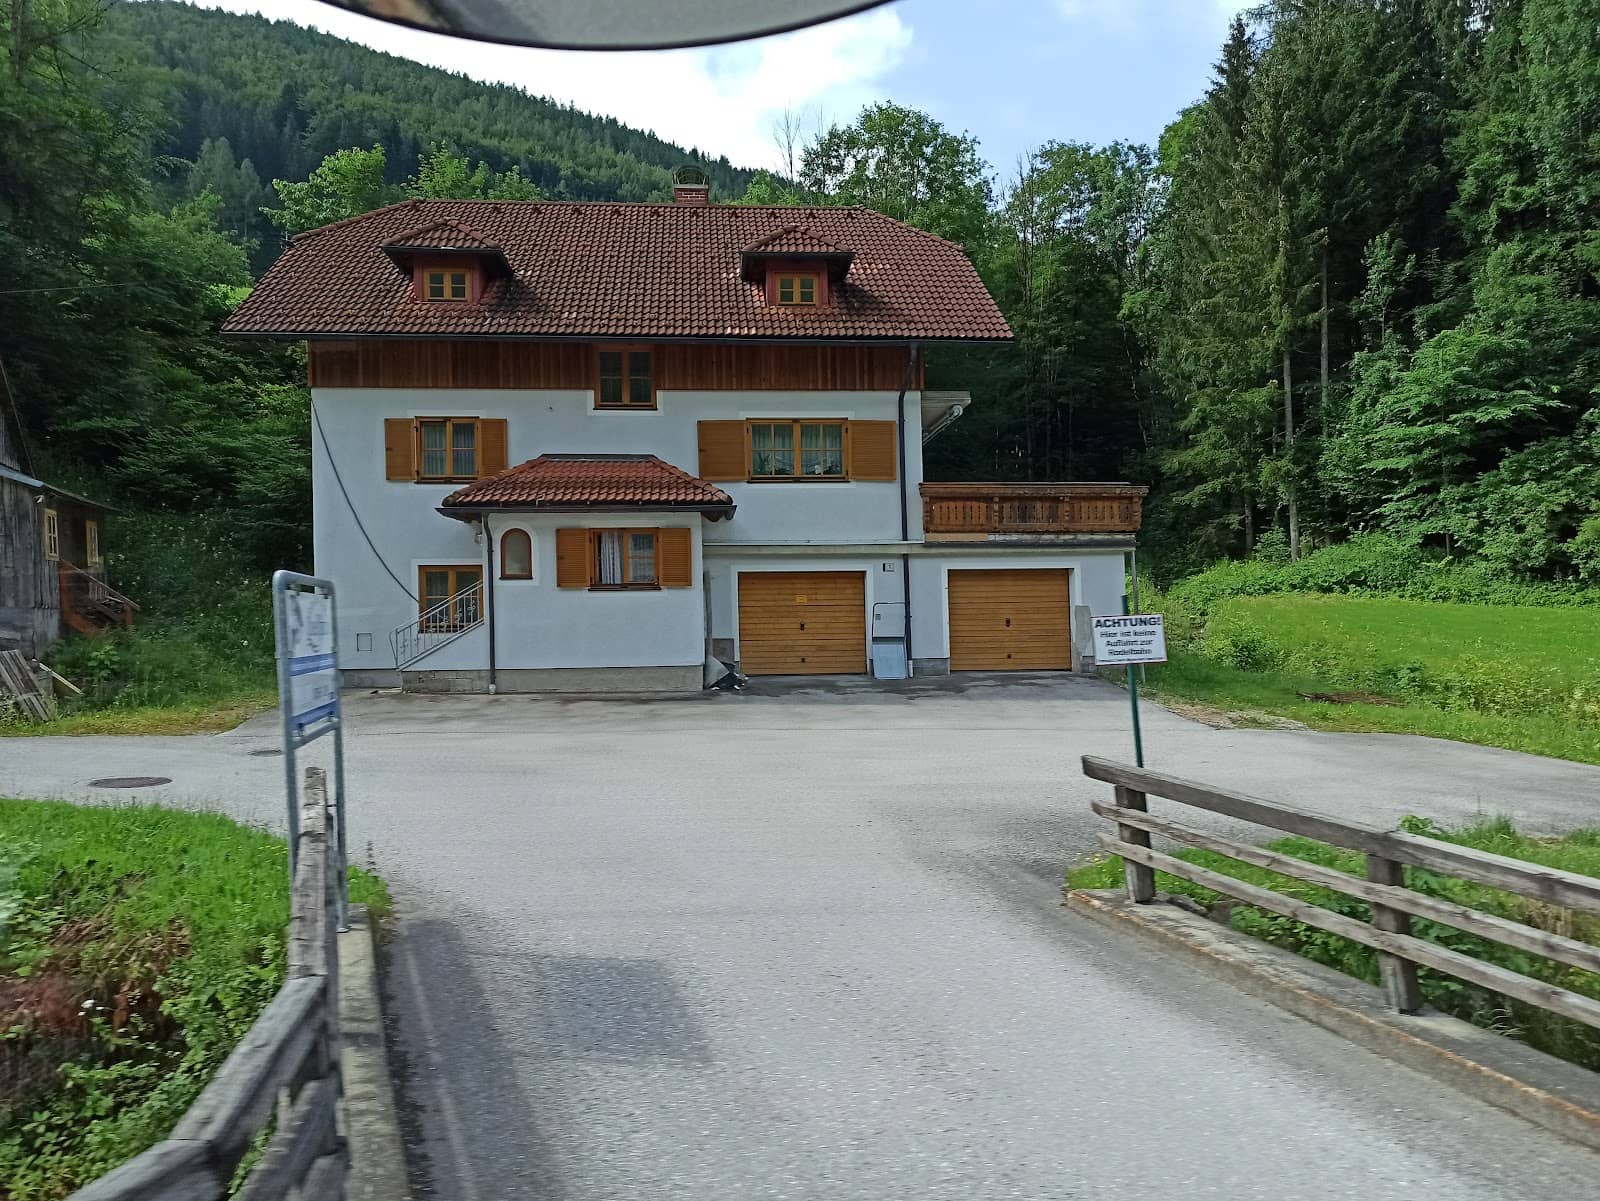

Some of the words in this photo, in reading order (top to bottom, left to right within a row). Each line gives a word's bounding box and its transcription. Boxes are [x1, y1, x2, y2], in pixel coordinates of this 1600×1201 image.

[1094, 616, 1161, 628] ACHTUNG!
[1100, 630, 1117, 638] Hier
[1133, 629, 1157, 637] keine
